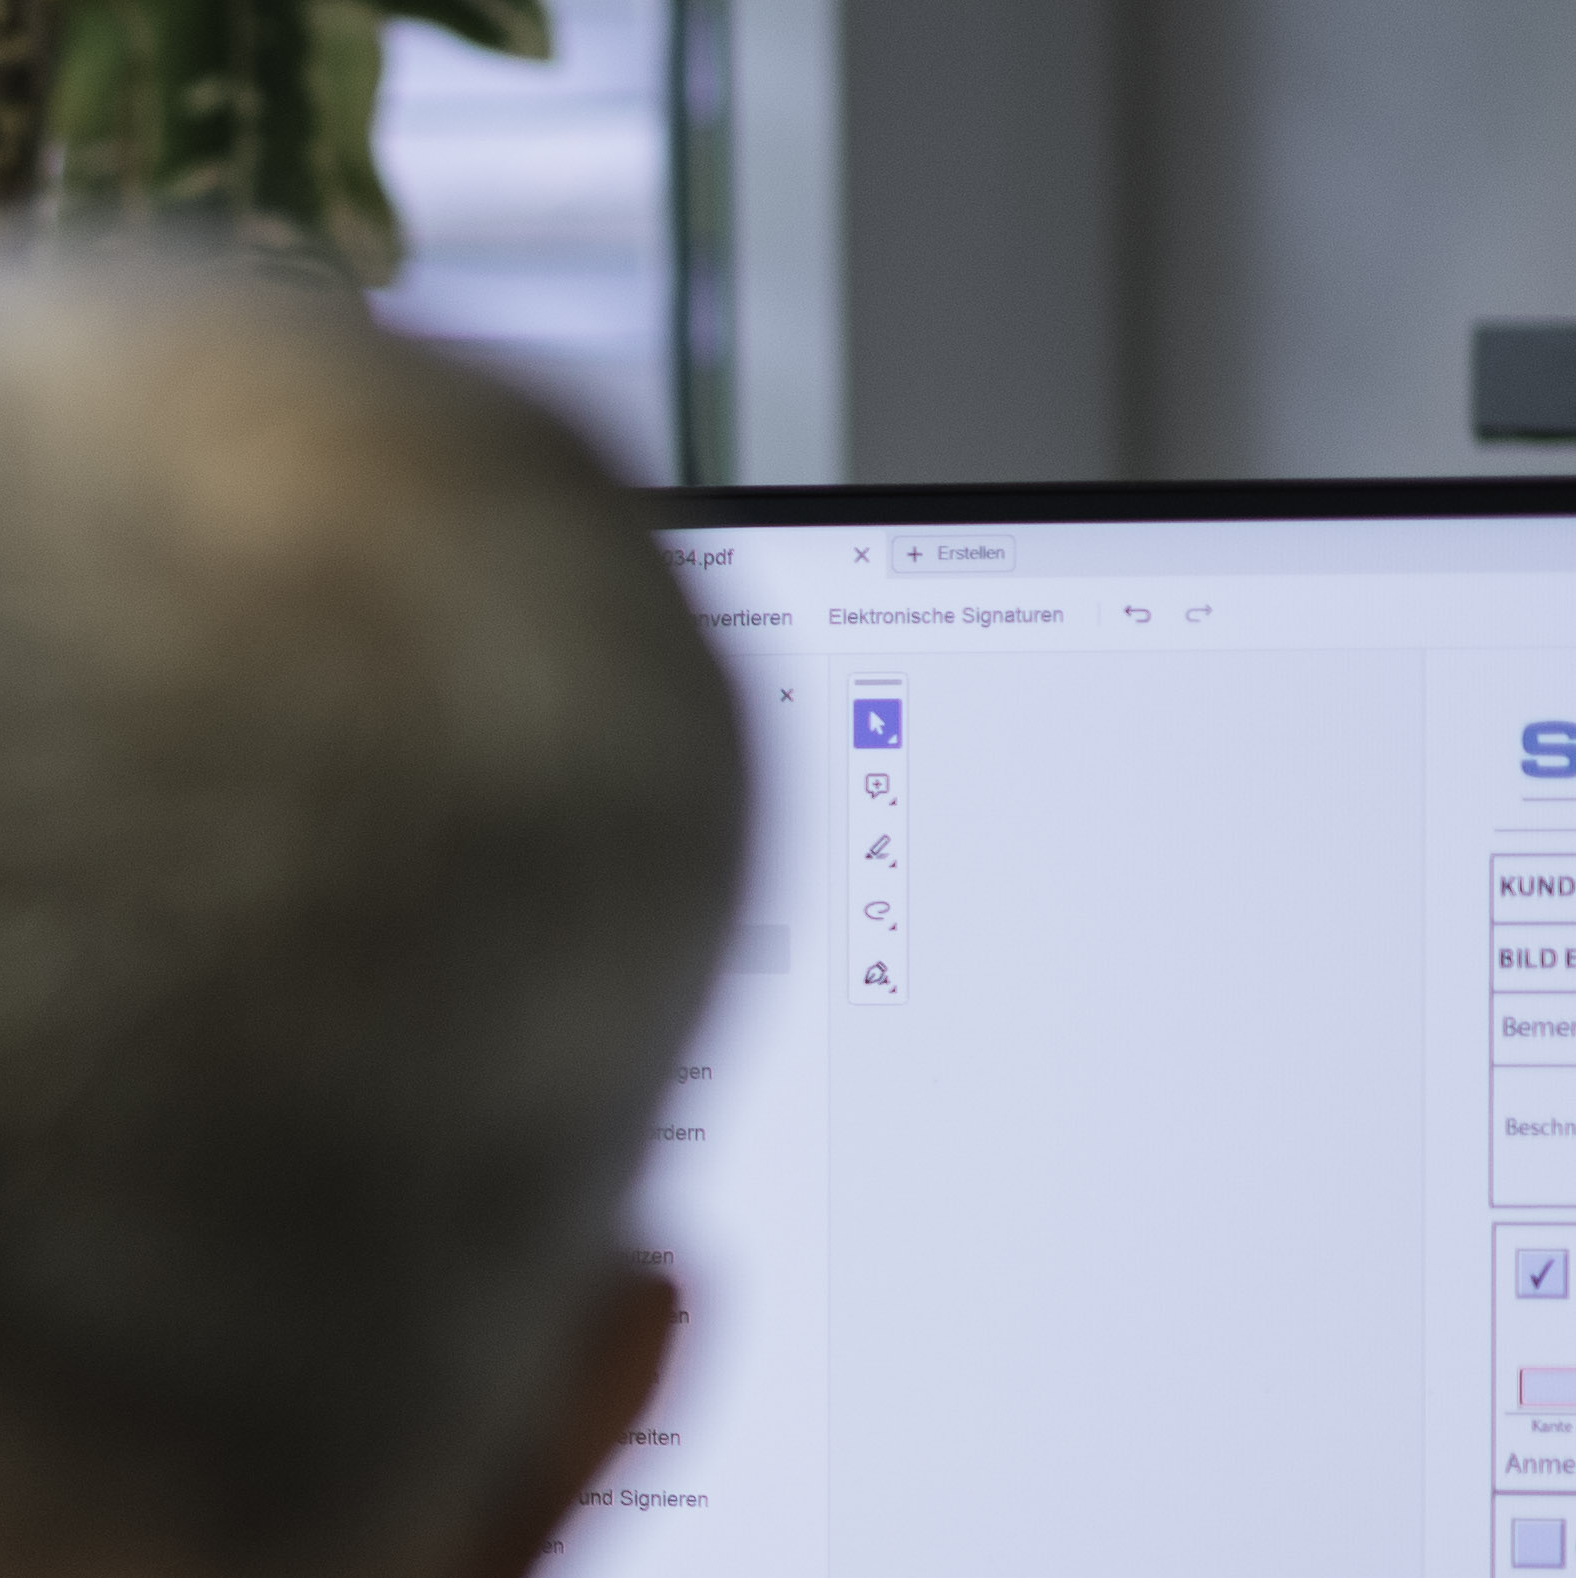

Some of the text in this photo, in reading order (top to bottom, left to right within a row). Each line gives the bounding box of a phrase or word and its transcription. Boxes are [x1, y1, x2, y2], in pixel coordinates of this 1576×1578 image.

[935, 543, 1006, 560] Erstellen
[829, 607, 1063, 627] Elektronische Signaturen
[1500, 876, 1575, 896] KUND
[1499, 948, 1556, 967] BILD
[1531, 1416, 1572, 1433] Kante
[620, 1489, 709, 1512] Signieren
